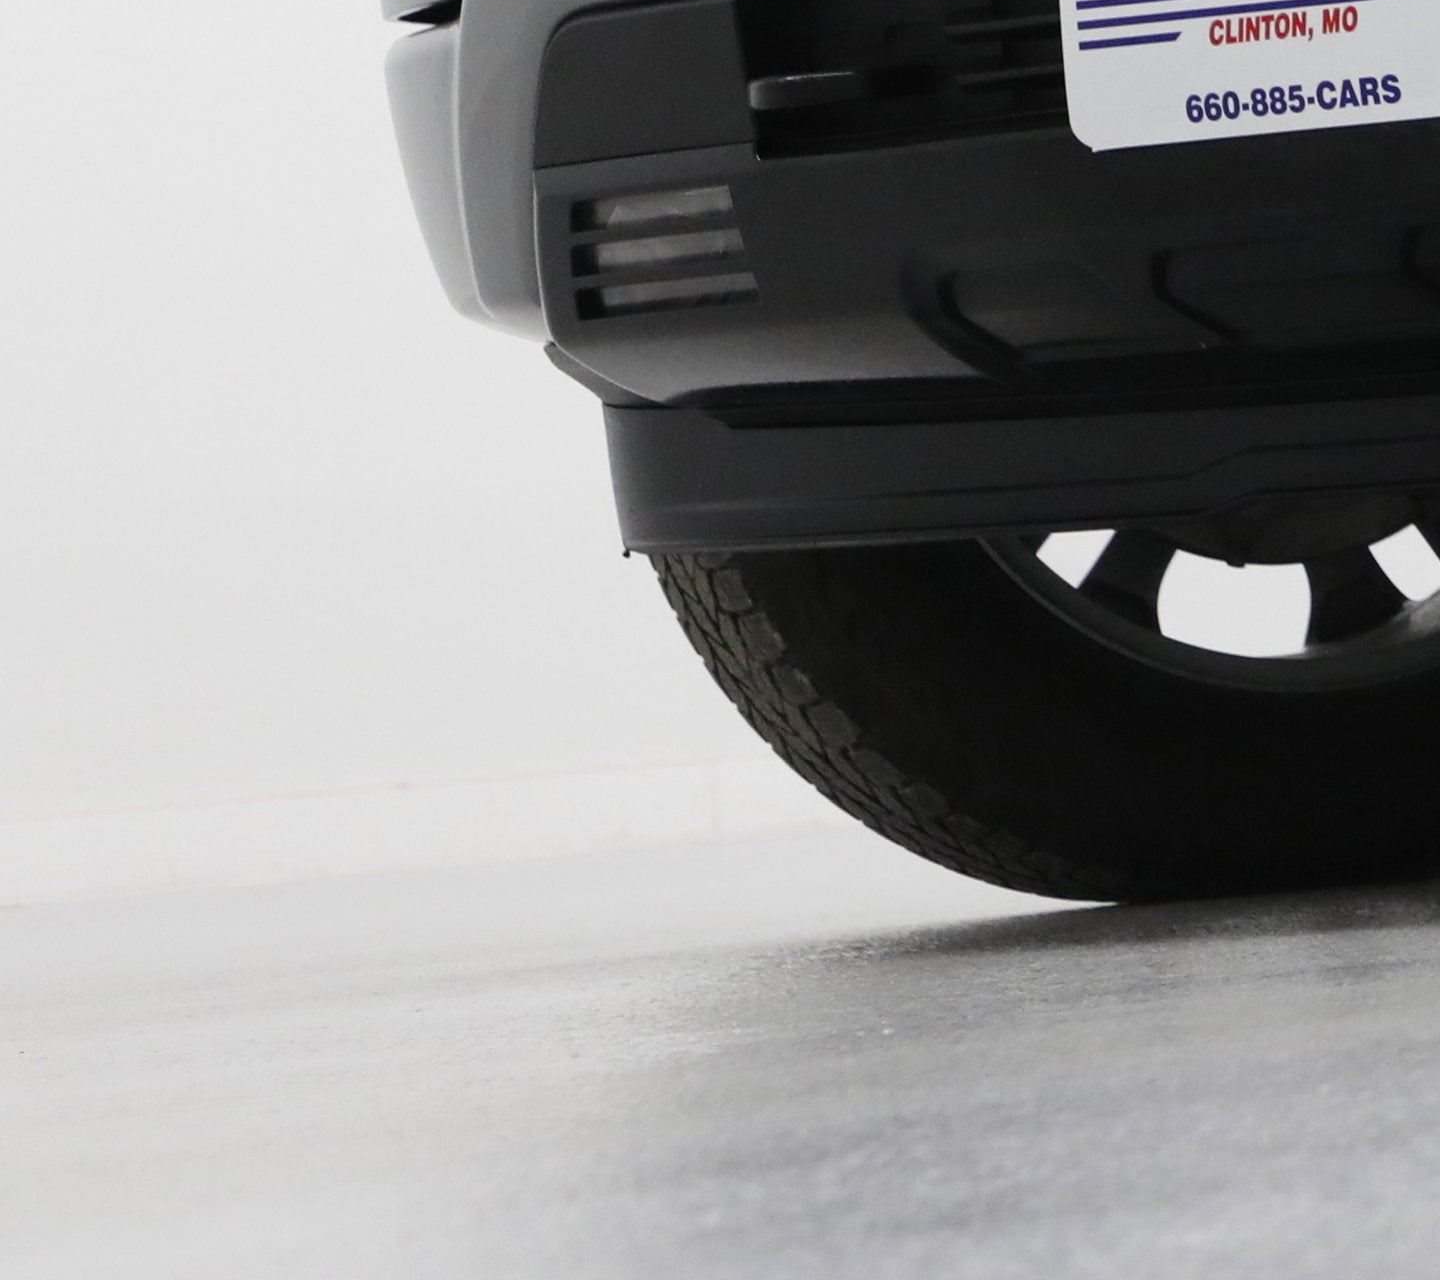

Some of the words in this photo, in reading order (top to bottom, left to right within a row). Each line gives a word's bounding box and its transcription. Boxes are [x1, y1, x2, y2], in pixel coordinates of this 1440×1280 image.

[1208, 10, 1314, 46] CLINTON,
[1322, 5, 1359, 34] MO
[1185, 74, 1402, 123] 660-885-CARS
